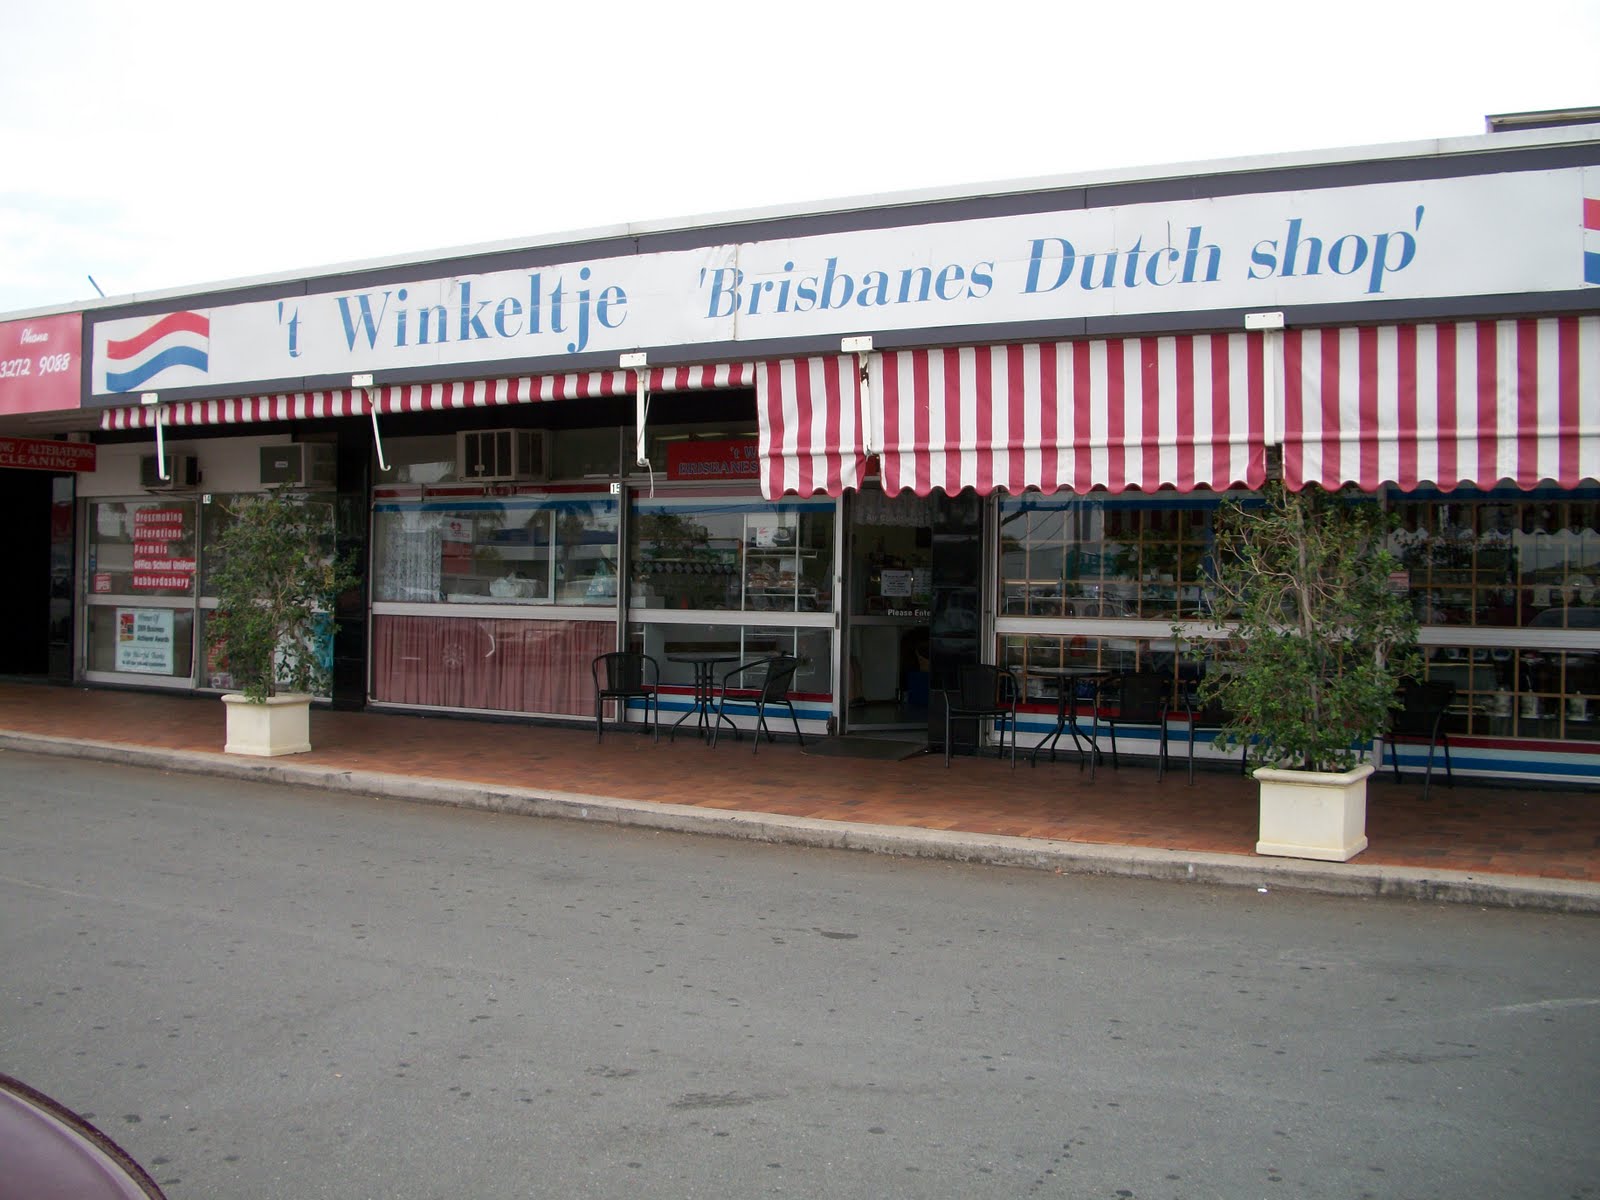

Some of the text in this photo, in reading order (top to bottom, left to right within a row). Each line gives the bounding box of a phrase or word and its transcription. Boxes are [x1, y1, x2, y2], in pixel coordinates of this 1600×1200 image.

[278, 205, 1425, 358] 't Winkeltje 'Brisbanes Dutch shop'
[21, 328, 48, 345] Phone
[0, 353, 70, 378] 3272 9088
[28, 443, 94, 458] ALTERATIONS
[0, 453, 77, 468] CLEANING
[678, 461, 758, 474] BRISBANES
[135, 512, 183, 523] Dressmaking
[134, 528, 181, 538] Alterations
[134, 544, 168, 554] Formals
[887, 608, 913, 617] Please
